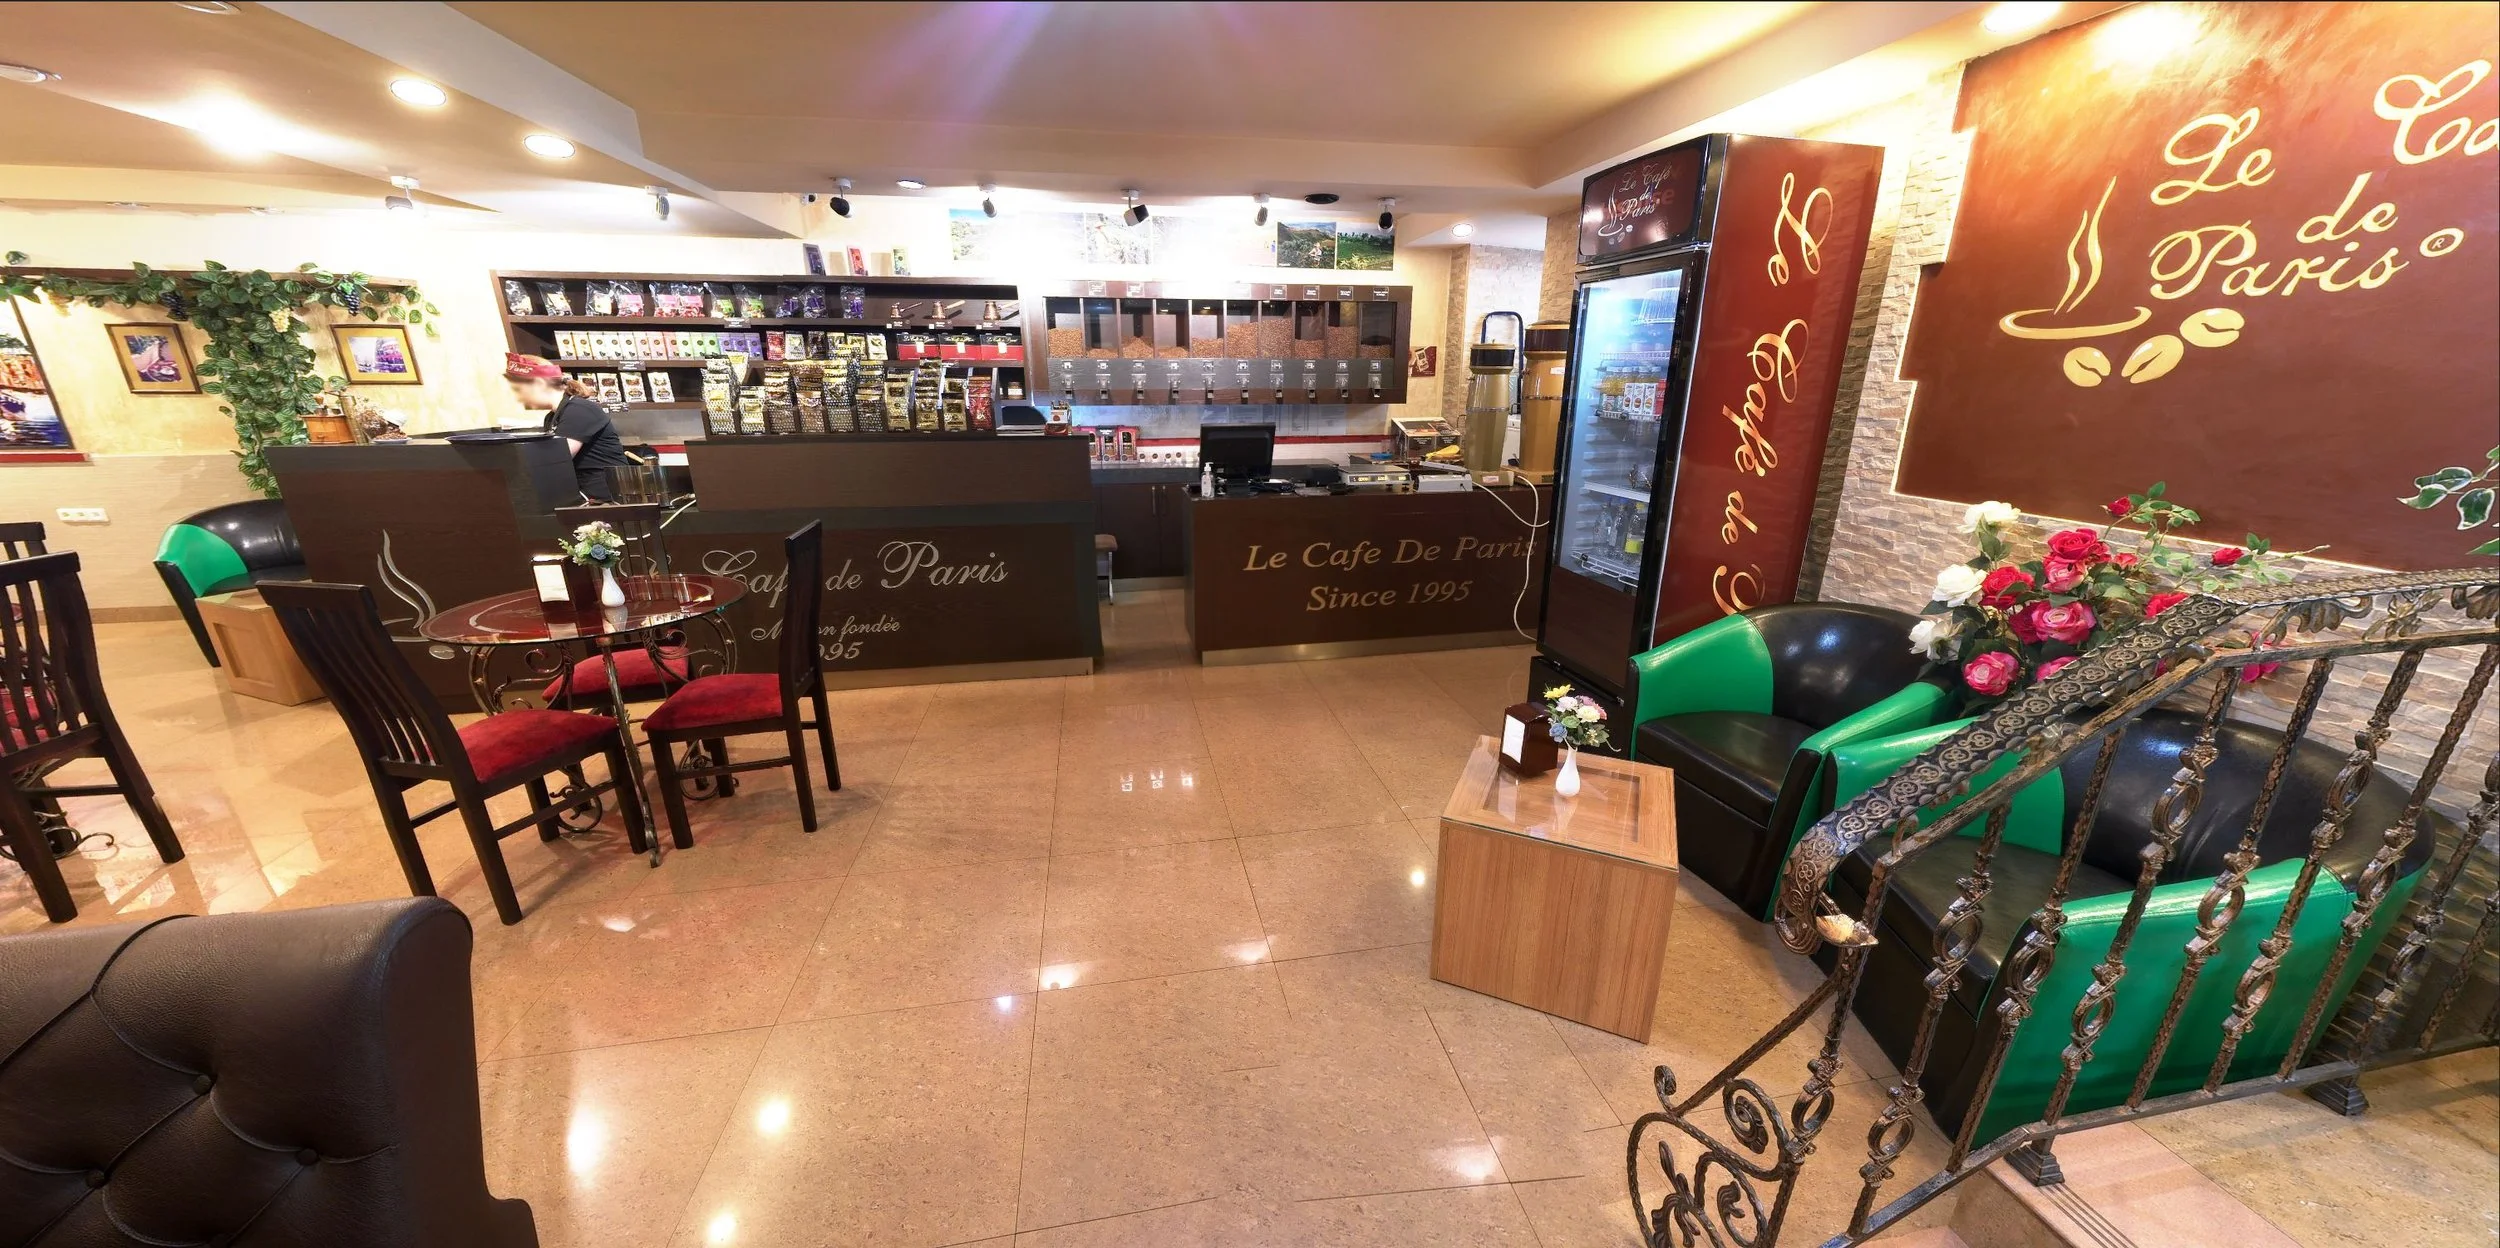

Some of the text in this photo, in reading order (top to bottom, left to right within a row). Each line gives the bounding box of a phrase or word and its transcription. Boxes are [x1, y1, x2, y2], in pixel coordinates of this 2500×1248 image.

[1619, 171, 1637, 193] Le
[2150, 107, 2275, 205] Le
[1620, 198, 1656, 220] Paris
[1639, 184, 1652, 200] de
[2296, 172, 2398, 243] de
[1768, 172, 1834, 287] Le
[2149, 220, 2409, 300] Paris
[1723, 318, 1809, 477] Café
[1722, 490, 1758, 544] de
[702, 550, 789, 608] Caf
[825, 559, 863, 591] de
[877, 541, 1008, 589] Paris
[1243, 536, 1537, 571] Le Cafe De Paris
[1306, 580, 1474, 611] Since 1995
[838, 614, 901, 643] fondée
